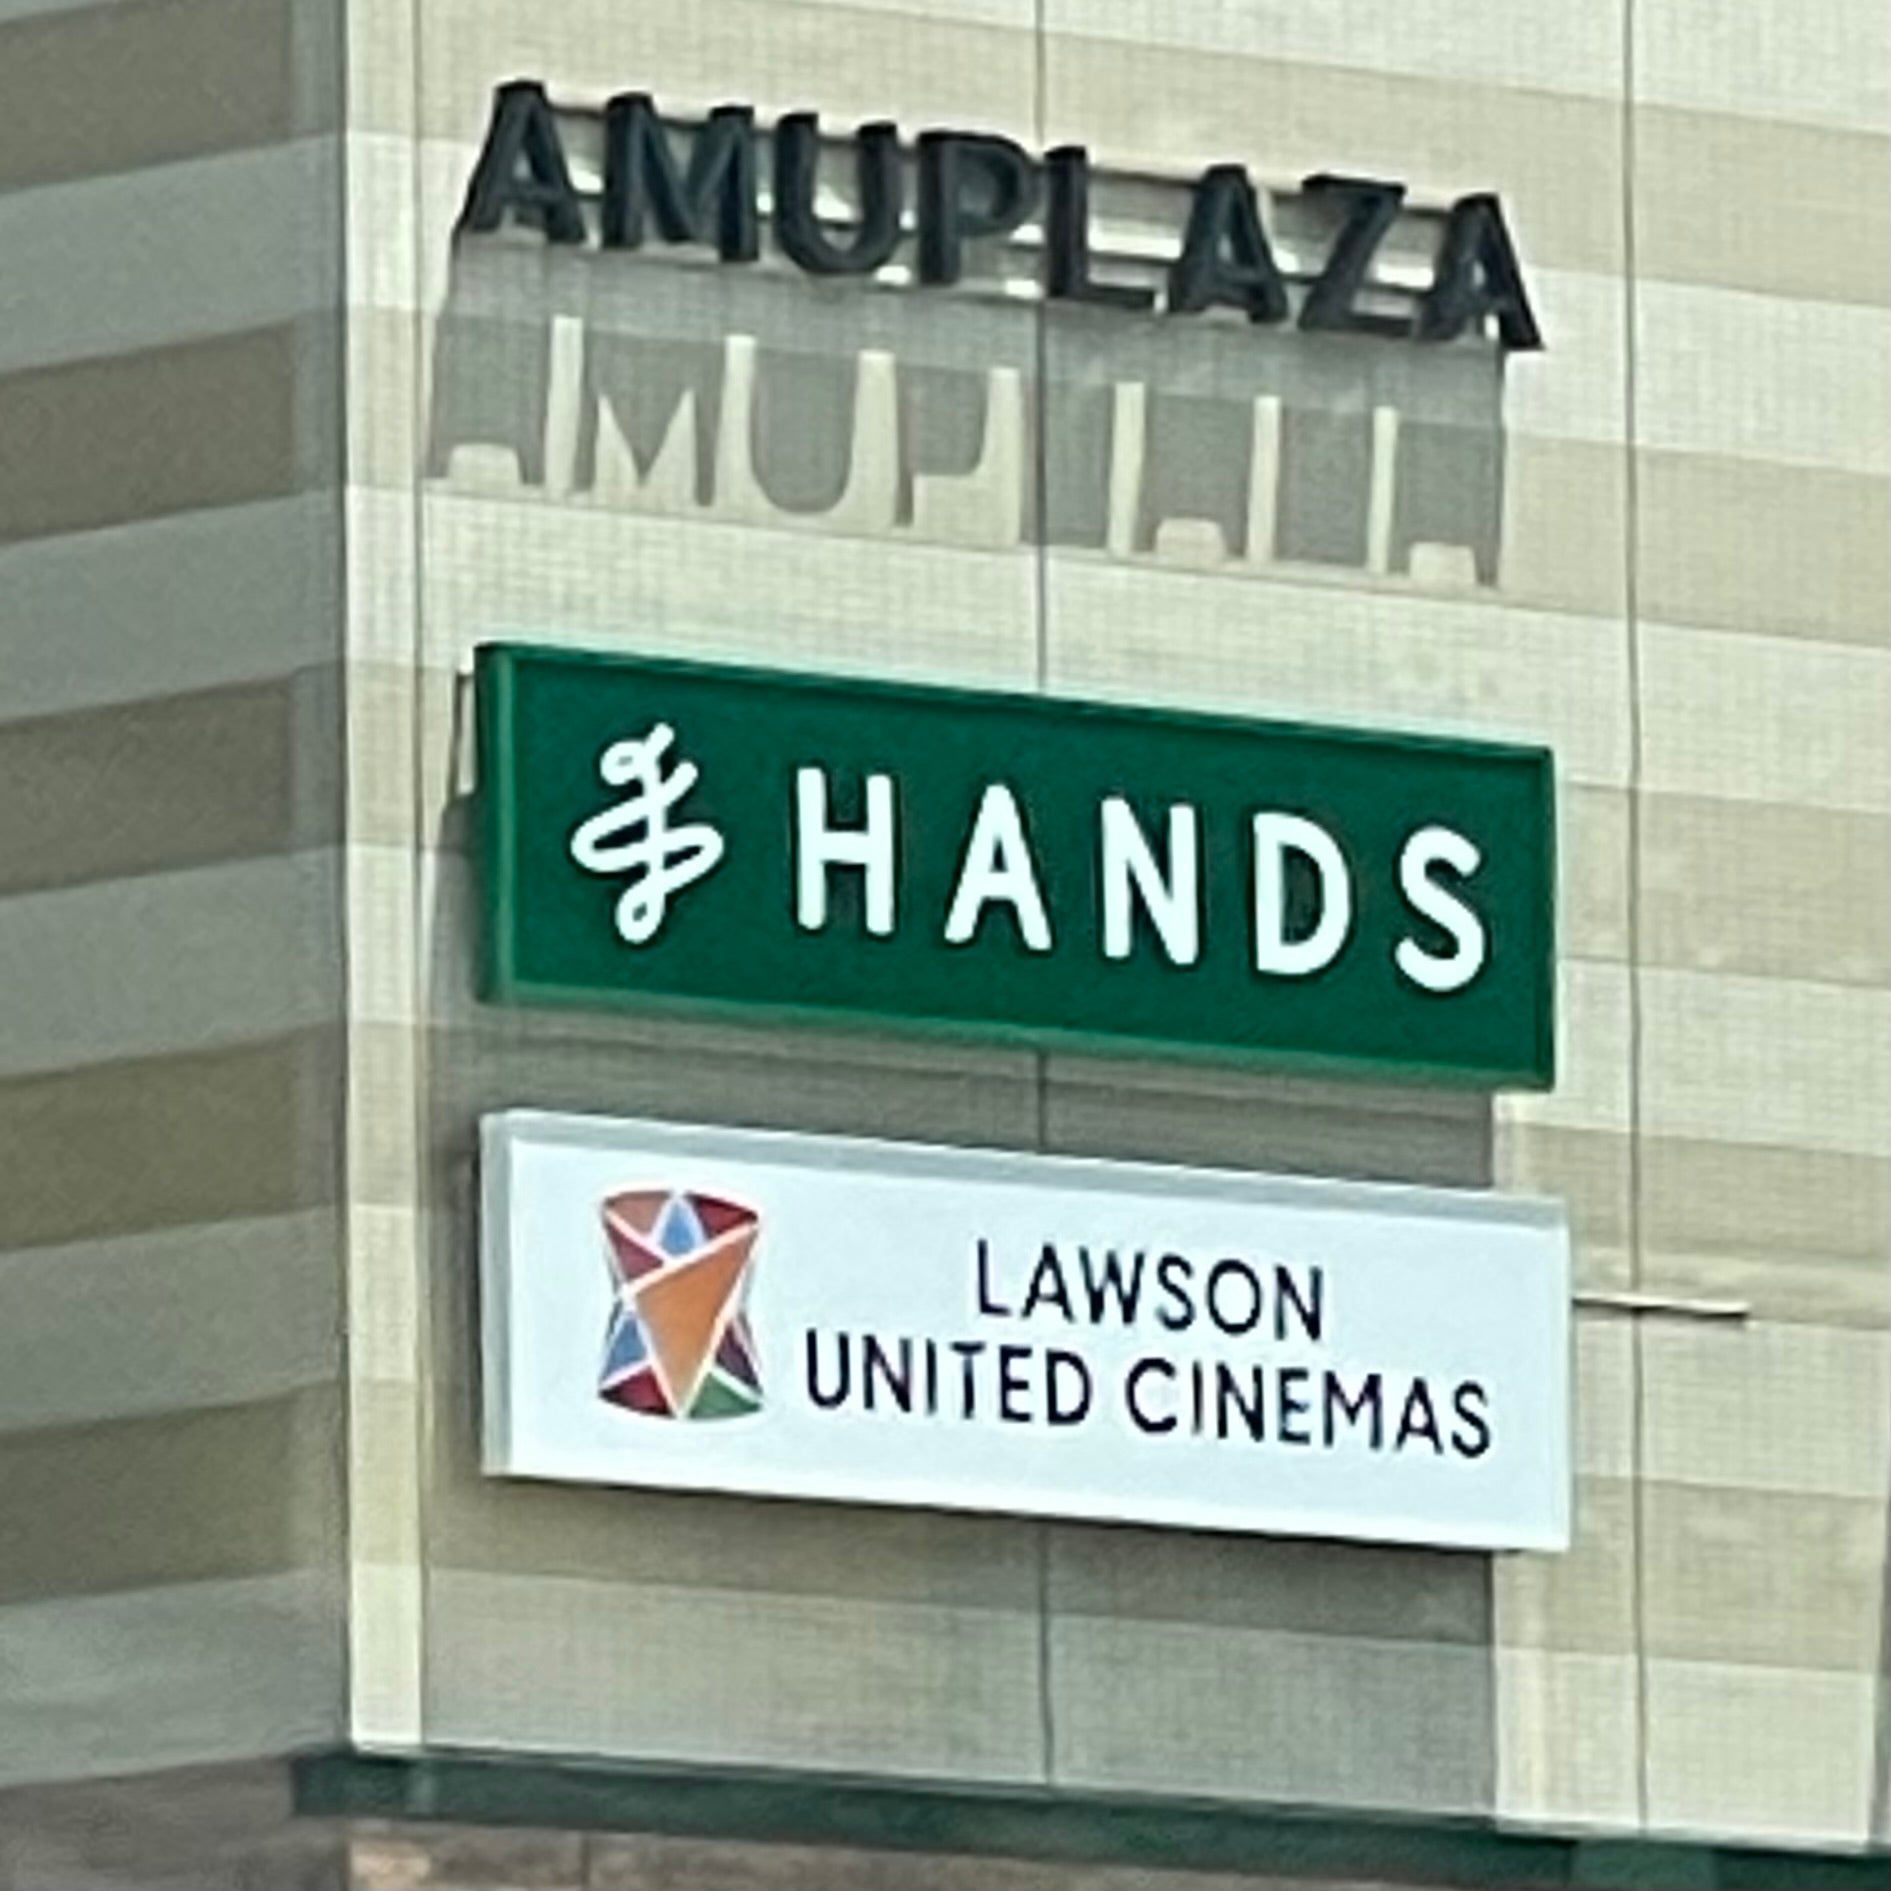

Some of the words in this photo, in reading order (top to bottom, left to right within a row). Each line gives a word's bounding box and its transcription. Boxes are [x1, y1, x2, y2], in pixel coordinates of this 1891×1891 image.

[466, 80, 1543, 351] AMUPLAZA
[795, 766, 1486, 993] HANDS
[974, 1239, 1324, 1341] LAWSON
[806, 1331, 1091, 1427] UNITED
[1125, 1357, 1492, 1459] CINEMAS
